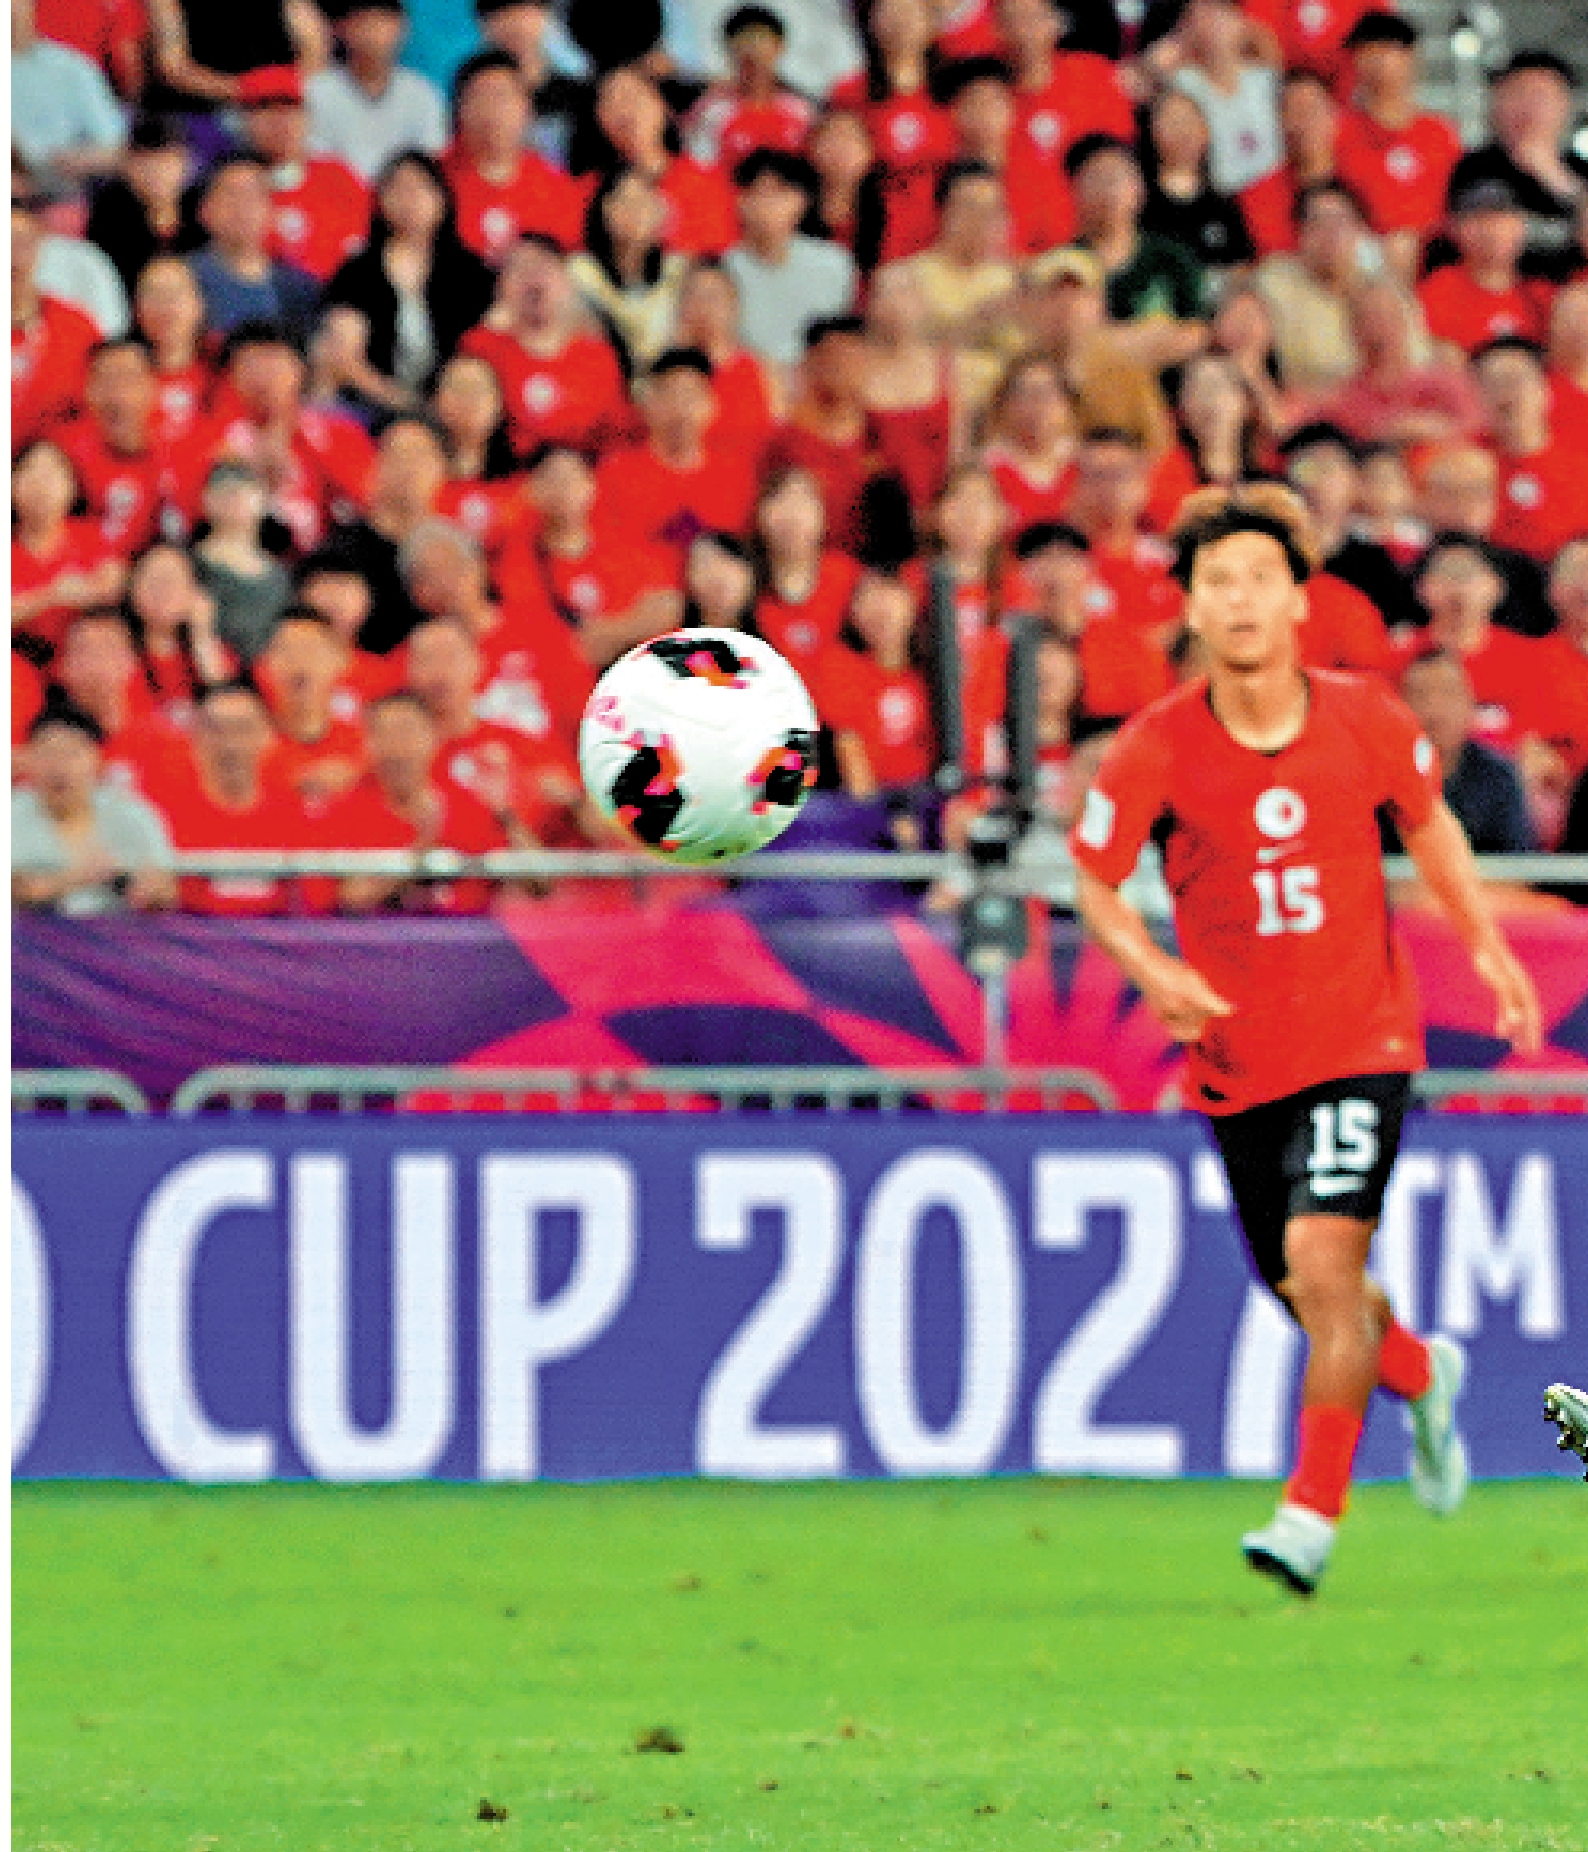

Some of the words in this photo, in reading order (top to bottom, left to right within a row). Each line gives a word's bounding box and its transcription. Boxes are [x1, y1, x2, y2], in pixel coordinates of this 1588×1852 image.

[1254, 866, 1324, 936] 15
[1306, 1098, 1379, 1171] 15
[127, 1150, 638, 1483] CUP
